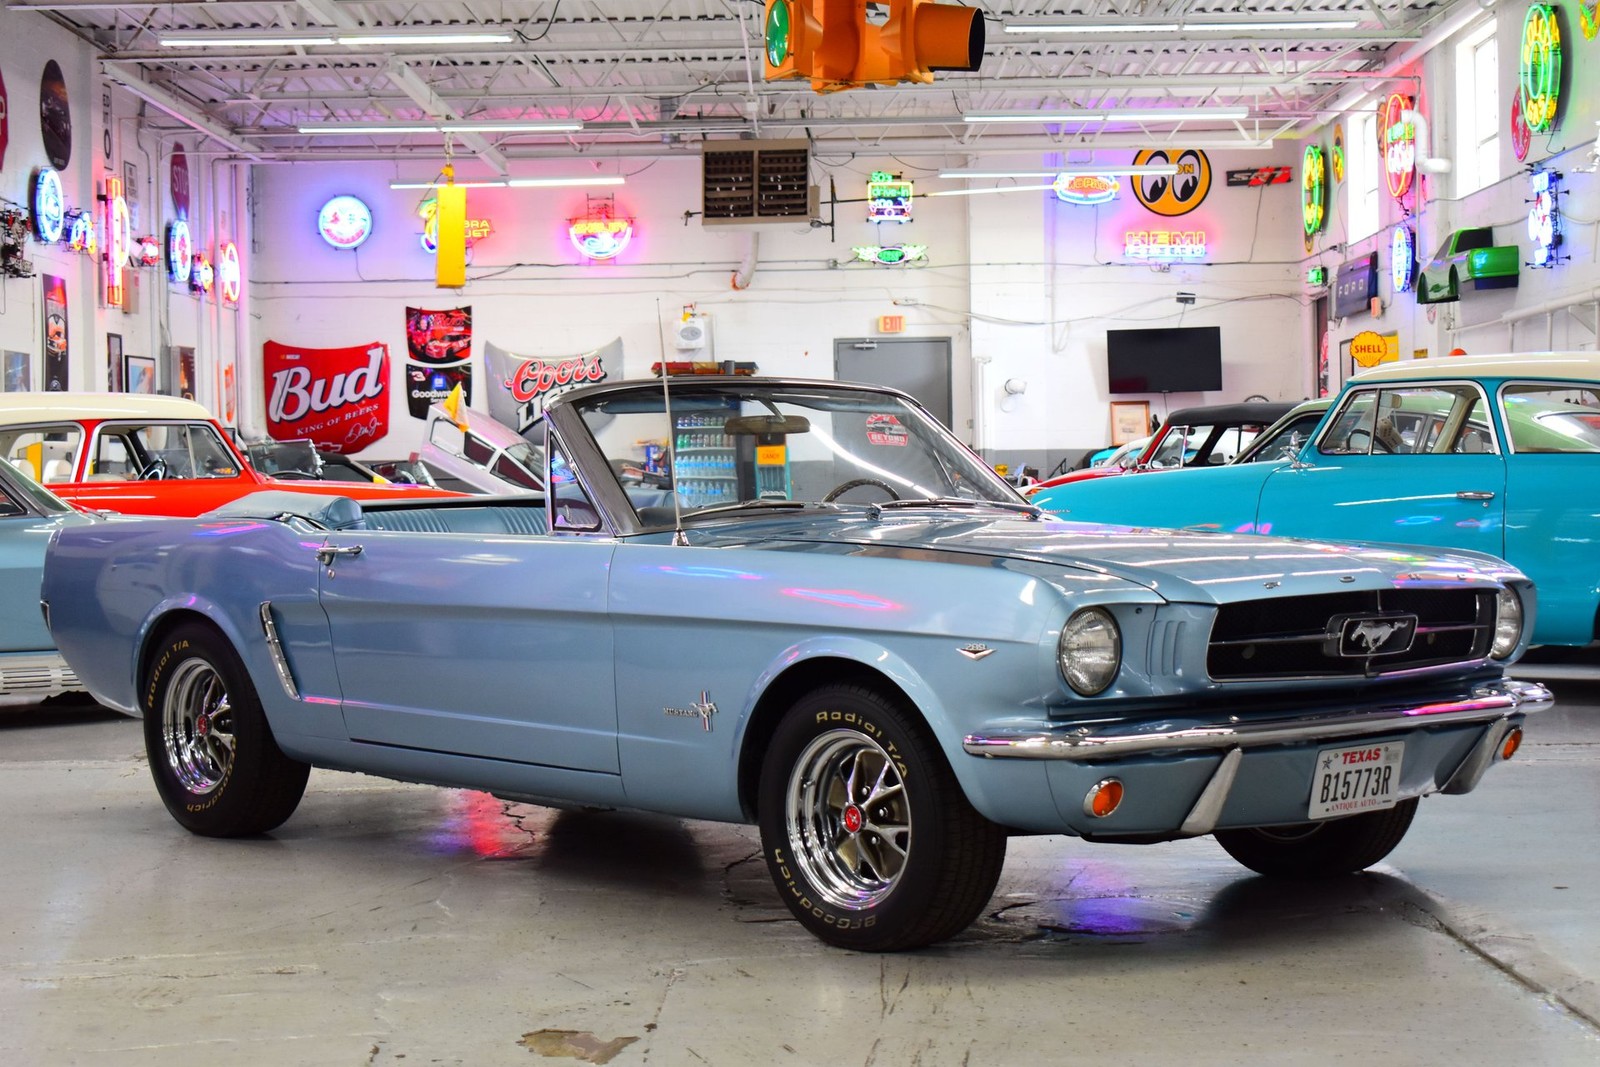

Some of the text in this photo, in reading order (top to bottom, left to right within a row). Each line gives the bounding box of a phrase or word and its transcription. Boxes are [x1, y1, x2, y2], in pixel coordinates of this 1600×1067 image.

[464, 219, 490, 229] BRA
[1125, 231, 1206, 247] HEMI
[1338, 279, 1364, 296] FORD
[883, 315, 903, 331] EXIT
[1354, 344, 1382, 354] SHELL
[268, 346, 384, 423] Bud
[504, 355, 605, 402] Coors
[296, 403, 379, 436] KING OF BEERS
[172, 639, 190, 654] T/A
[147, 652, 171, 708] Radial
[663, 707, 700, 718] MUSTANG
[815, 710, 909, 778] Radial T/A
[1342, 747, 1381, 765] TEXAS
[1320, 765, 1392, 804] B15773R
[1330, 799, 1377, 812] ANTIQUE AUTO
[774, 847, 877, 930] BFGoodrich
